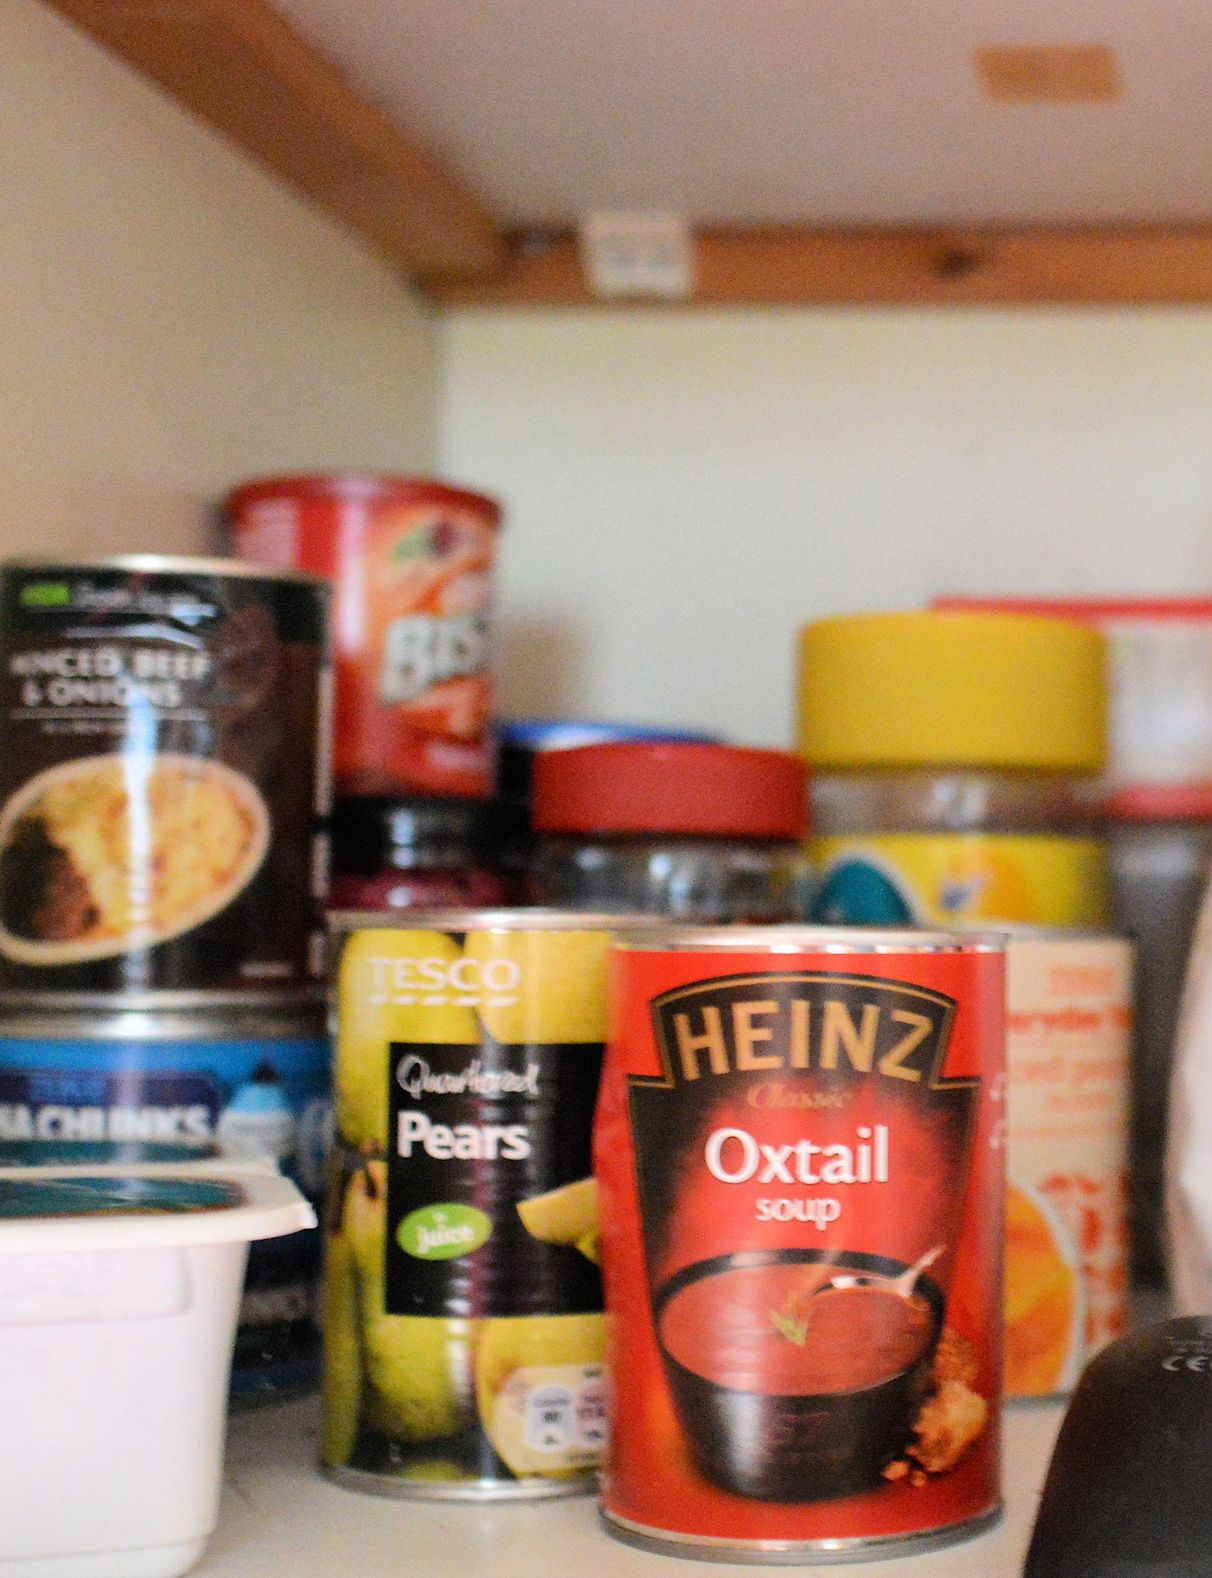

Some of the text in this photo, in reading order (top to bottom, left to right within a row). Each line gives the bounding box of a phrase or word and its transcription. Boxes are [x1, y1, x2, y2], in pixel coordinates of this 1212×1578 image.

[365, 956, 521, 993] TESCO
[672, 998, 935, 1085] HEINZ
[397, 1109, 532, 1161] Pears
[704, 1123, 891, 1186] Oxtail
[755, 1194, 843, 1231] soup
